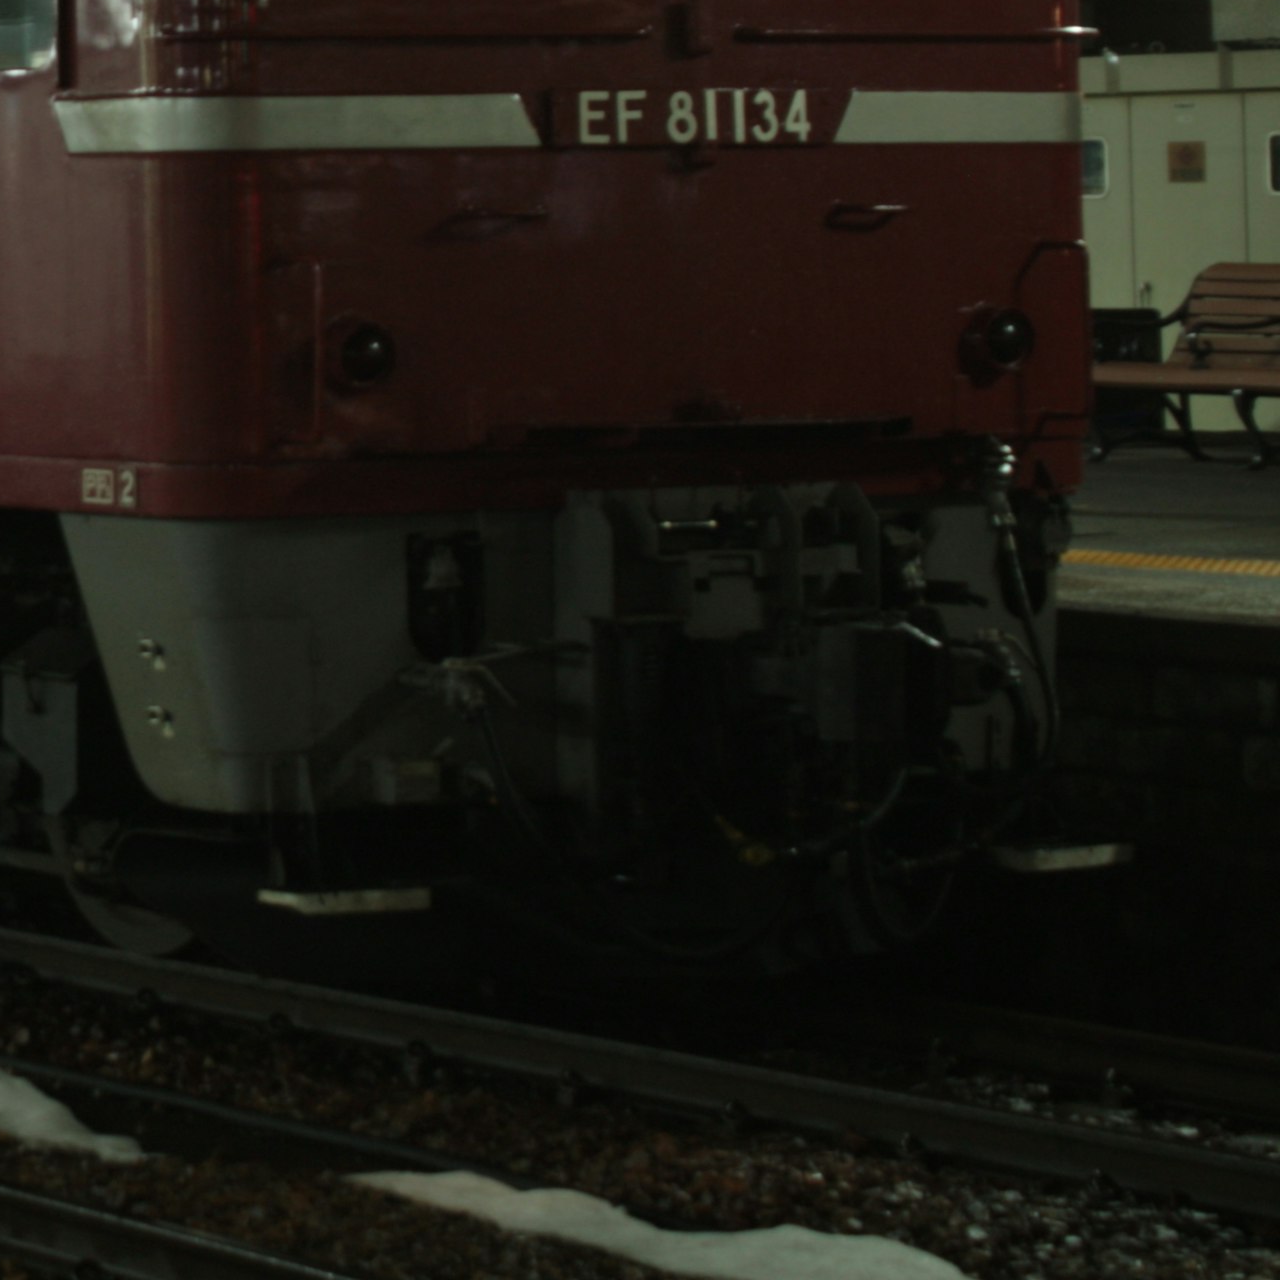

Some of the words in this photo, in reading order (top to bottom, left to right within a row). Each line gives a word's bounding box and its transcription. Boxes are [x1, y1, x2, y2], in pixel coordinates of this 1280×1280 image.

[578, 90, 647, 144] EF
[667, 88, 811, 143] 81134
[121, 470, 136, 506] 2
